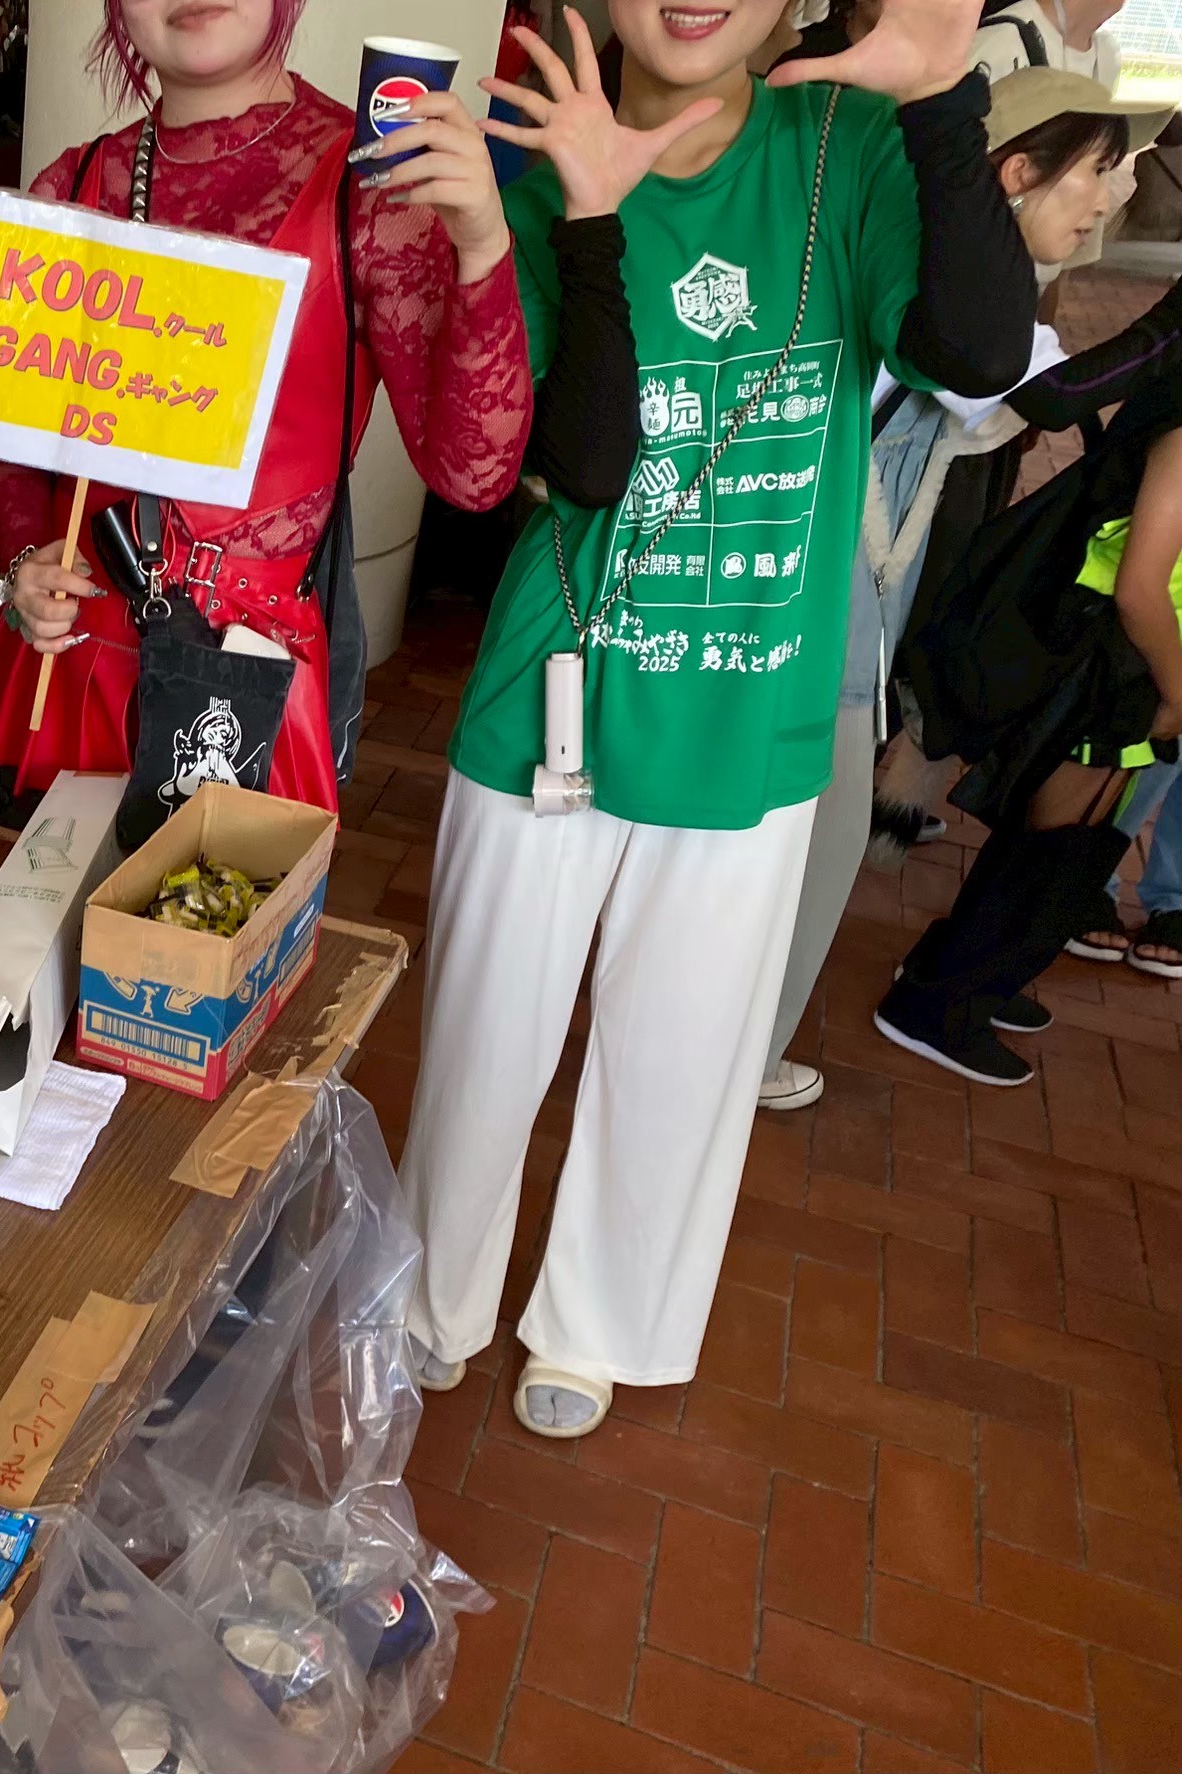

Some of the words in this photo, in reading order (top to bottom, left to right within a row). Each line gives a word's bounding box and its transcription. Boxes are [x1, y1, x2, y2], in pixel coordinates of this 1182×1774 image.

[163, 312, 228, 348] クール
[126, 371, 219, 413] ギャング
[59, 403, 118, 446] DS
[701, 631, 761, 645] 全ての人に
[638, 656, 681, 672] 2025
